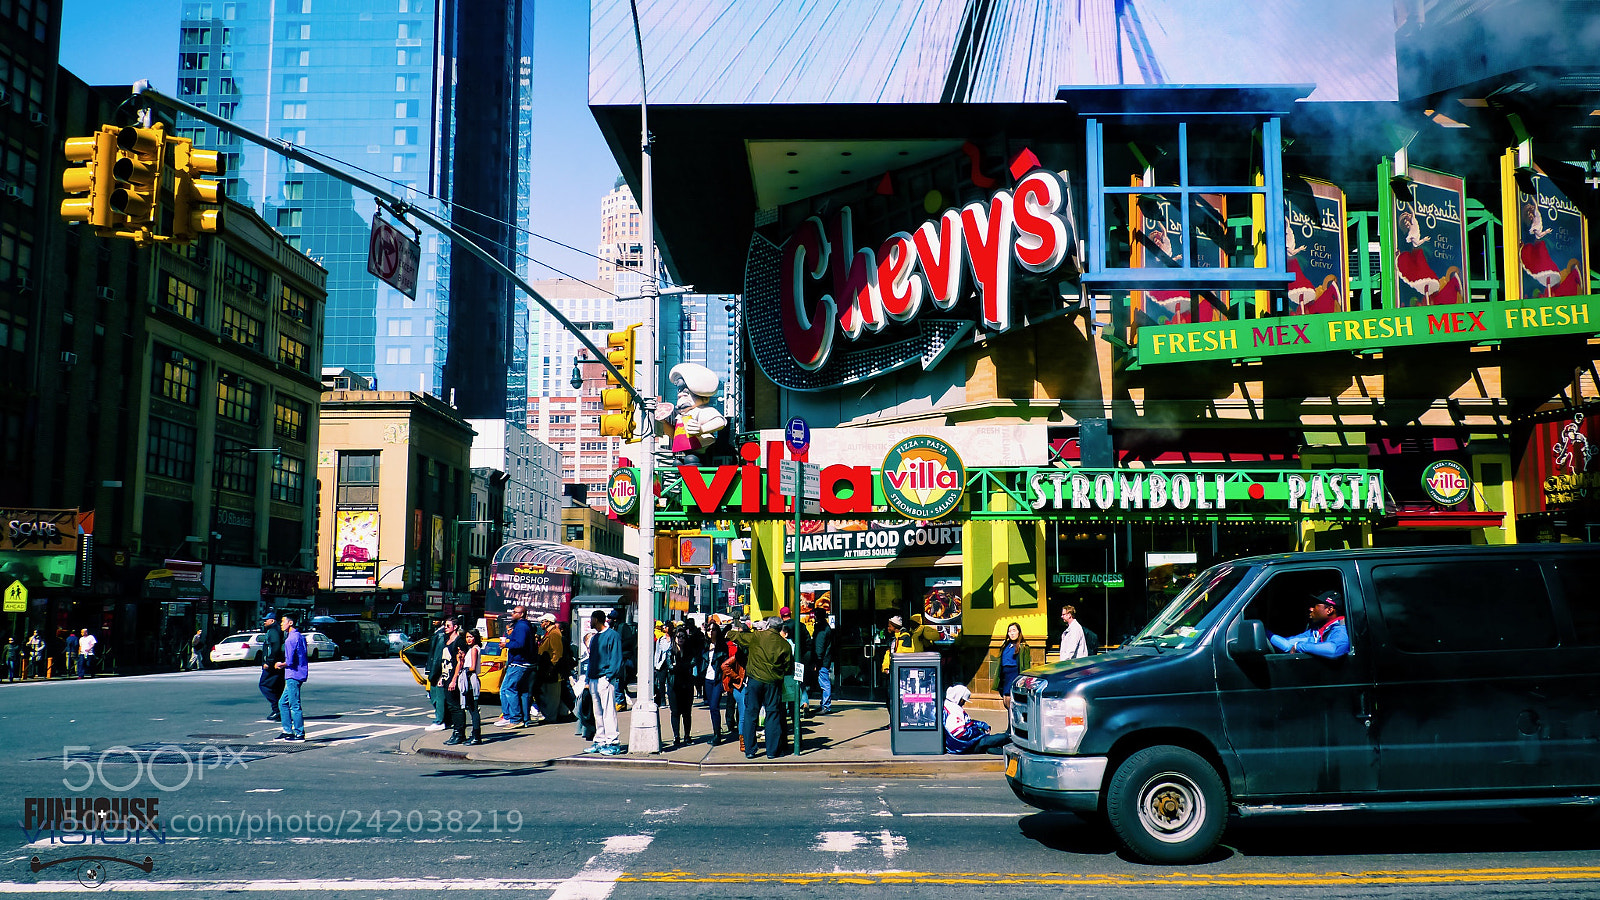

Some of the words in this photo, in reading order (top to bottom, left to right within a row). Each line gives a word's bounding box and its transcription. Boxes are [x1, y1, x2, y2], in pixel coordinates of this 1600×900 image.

[1310, 249, 1332, 260] FRESH
[1313, 243, 1326, 252] GET
[779, 147, 1068, 373] Chevy's
[1152, 328, 1238, 355] FRESH
[1252, 323, 1312, 348] MEX
[1327, 315, 1413, 342] FRESH
[1427, 310, 1488, 335] MEX
[1504, 303, 1590, 329] FRESH
[977, 427, 1000, 435] FRESH
[896, 440, 918, 454] PIZZA
[926, 440, 948, 454] PASTA
[885, 461, 958, 490] villa
[1427, 474, 1466, 489] villa
[609, 482, 635, 498] villa
[1030, 472, 1225, 510] STROMBOLI
[1288, 473, 1383, 510] PASTA
[890, 493, 929, 517] STROMBOLI
[935, 492, 957, 514] SALADS
[8, 520, 56, 538] SCARE
[856, 530, 900, 549] FOOD
[904, 526, 962, 547] COURT
[844, 550, 853, 558] AT
[853, 549, 871, 557] TIMES
[872, 548, 896, 557] SQUARE
[508, 574, 550, 585] TOPSHOP
[1052, 574, 1090, 583] INTERNET
[1092, 574, 1123, 583] ACCESS
[508, 583, 549, 592] TOPMAN
